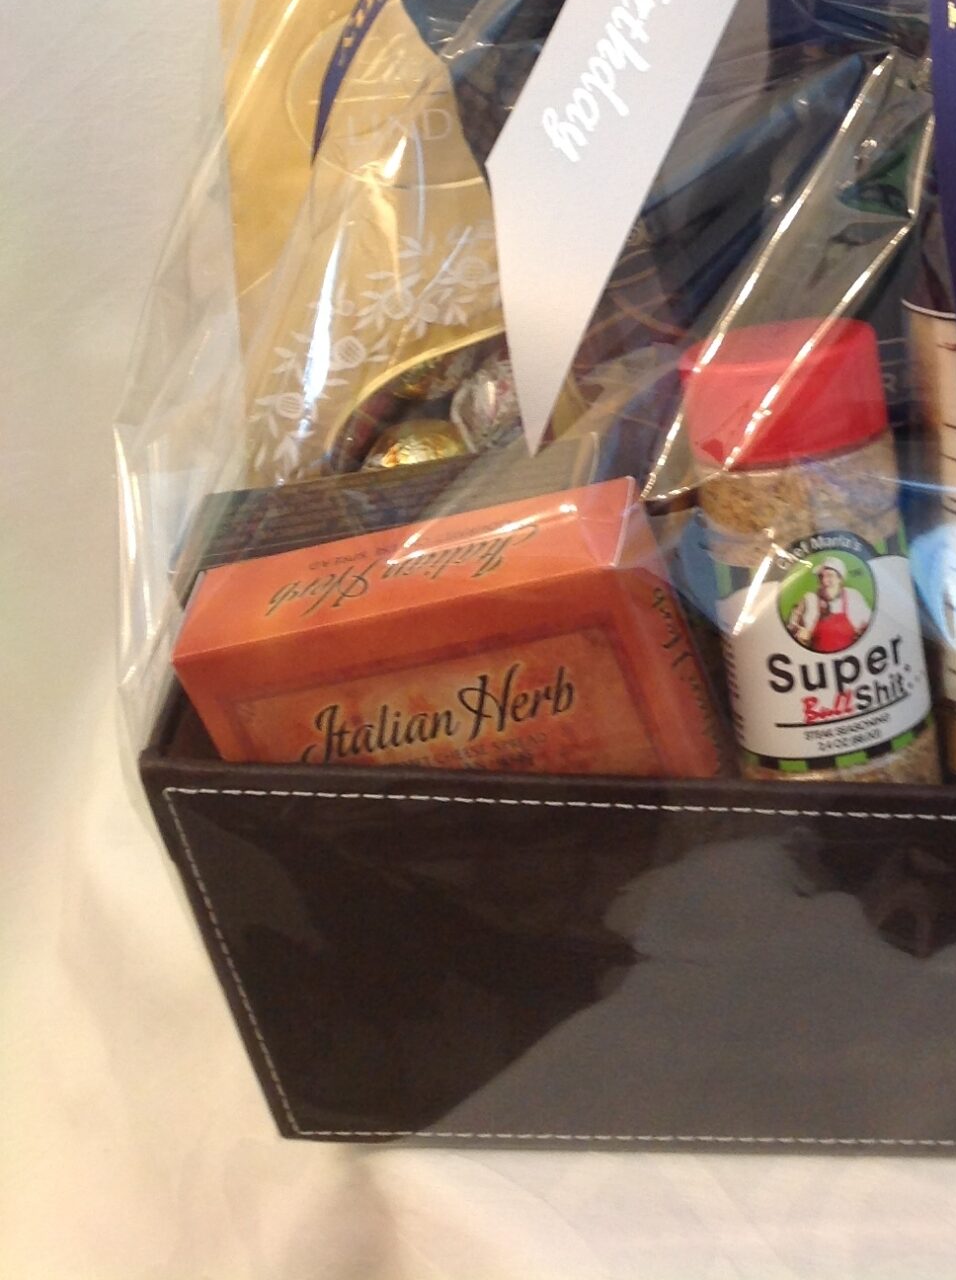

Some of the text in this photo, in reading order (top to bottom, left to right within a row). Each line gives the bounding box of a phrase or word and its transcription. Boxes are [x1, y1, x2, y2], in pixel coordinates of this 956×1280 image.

[767, 631, 903, 695] Super
[299, 661, 576, 762] Italian Herb
